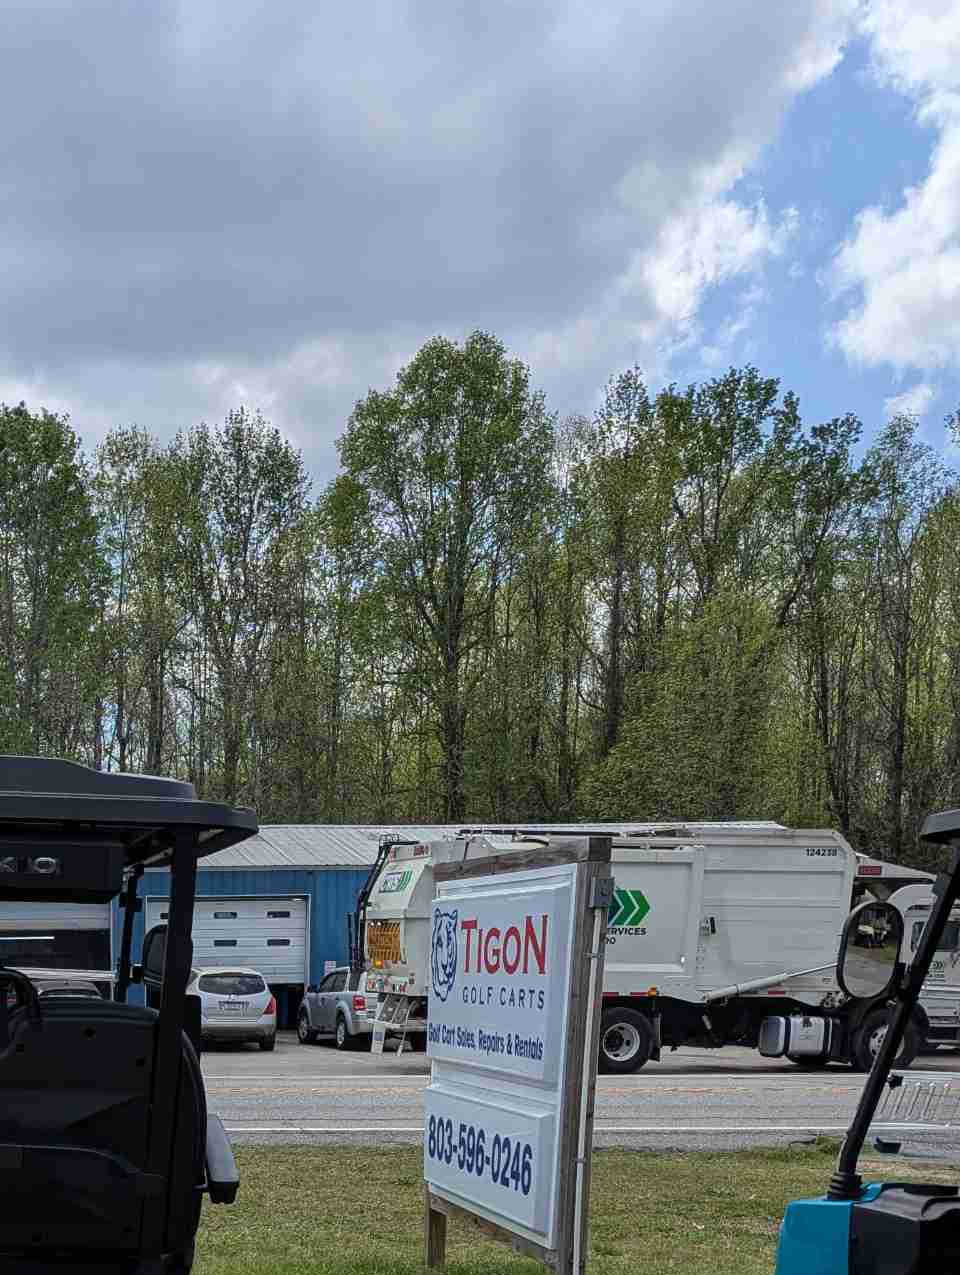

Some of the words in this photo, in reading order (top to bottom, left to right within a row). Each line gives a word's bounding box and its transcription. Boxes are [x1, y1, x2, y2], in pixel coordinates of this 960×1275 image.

[606, 927, 647, 936] ERVICES
[462, 986, 494, 1005] GOLF
[499, 987, 545, 1010] CARTS
[428, 1022, 441, 1042] Golf
[441, 1024, 456, 1046] Cart
[478, 1029, 505, 1056] Repairs
[506, 1033, 513, 1055] &
[514, 1034, 544, 1061] Rentals
[428, 1114, 533, 1196] 803-596-0246
